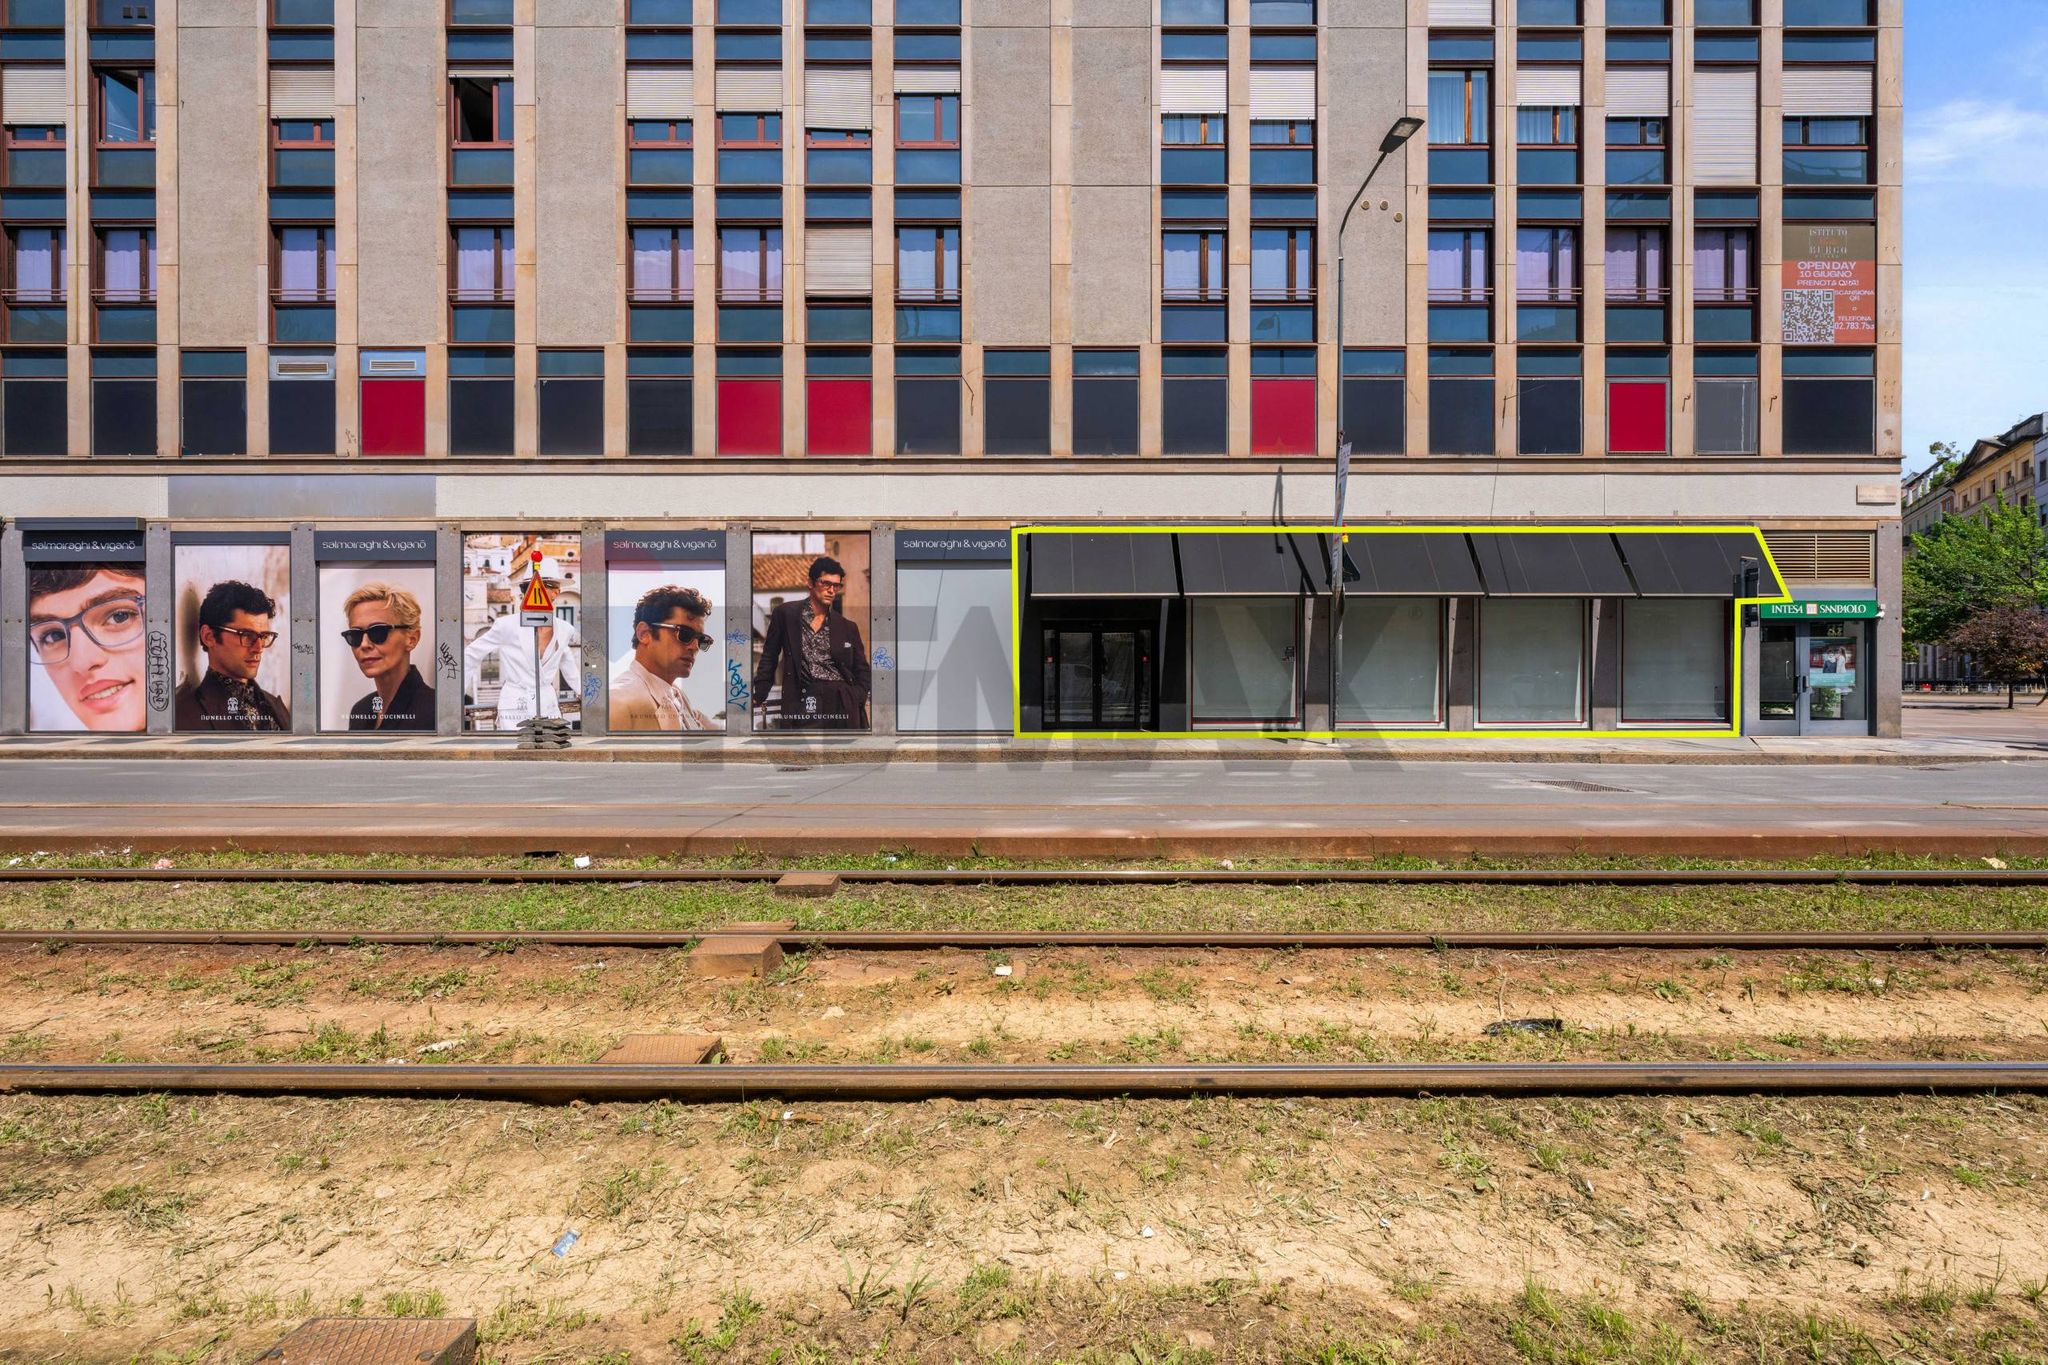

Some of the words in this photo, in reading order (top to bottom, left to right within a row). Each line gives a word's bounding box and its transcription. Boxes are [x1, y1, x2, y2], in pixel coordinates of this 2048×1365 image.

[1797, 261, 1831, 270] OPEN
[1832, 261, 1857, 270] DAY
[1799, 270, 1812, 278] 10
[1813, 270, 1853, 278] GIUGNO
[31, 541, 91, 552] salmoiraghi
[92, 541, 100, 550] &
[322, 540, 382, 551] salmoiraghi
[382, 540, 391, 550] &
[613, 539, 672, 550] salmoiraghi
[673, 539, 681, 549] &
[903, 538, 962, 550] salmoiraghi
[963, 538, 970, 548] &
[1771, 604, 1803, 614] INTESA
[1819, 604, 1867, 614] SANPAOLO
